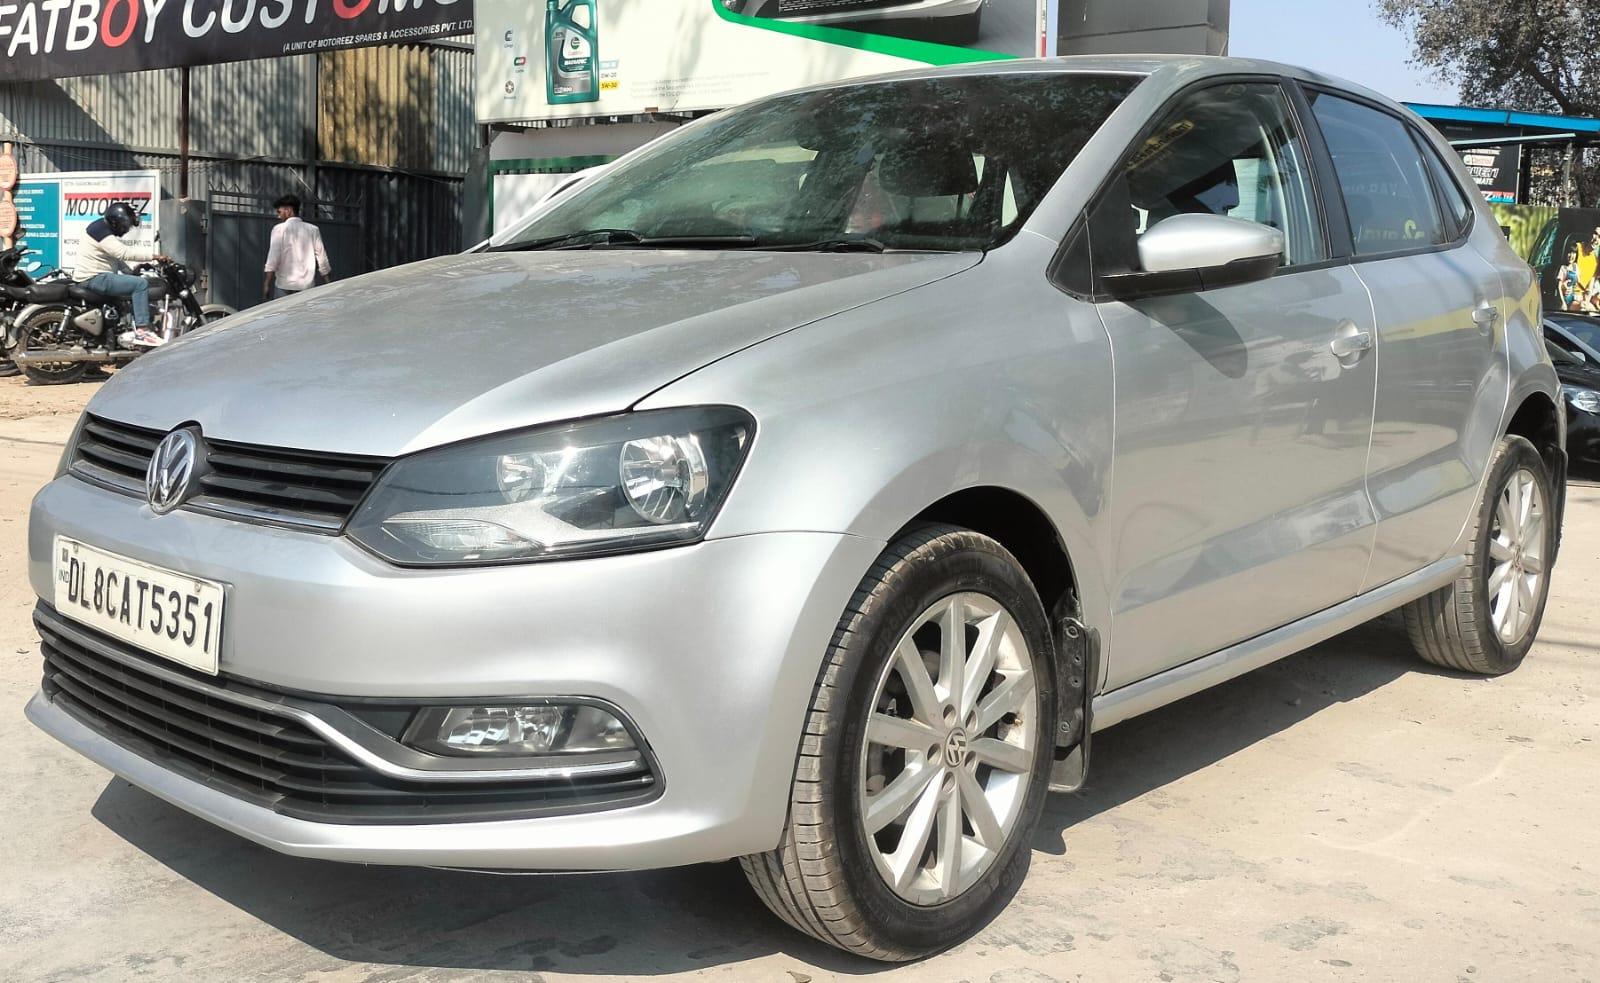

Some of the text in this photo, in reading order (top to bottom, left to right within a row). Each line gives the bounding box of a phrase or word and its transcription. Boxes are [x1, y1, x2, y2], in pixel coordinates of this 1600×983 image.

[291, 41, 307, 51] UNIT
[307, 40, 318, 49] OF
[317, 36, 354, 47] MOTOREEZ
[355, 32, 382, 44] SPARES
[383, 31, 388, 40] &
[389, 24, 440, 39] ACCESSORIES
[65, 198, 150, 217] MOTOEZ
[68, 556, 213, 653] DL8CAT5351
